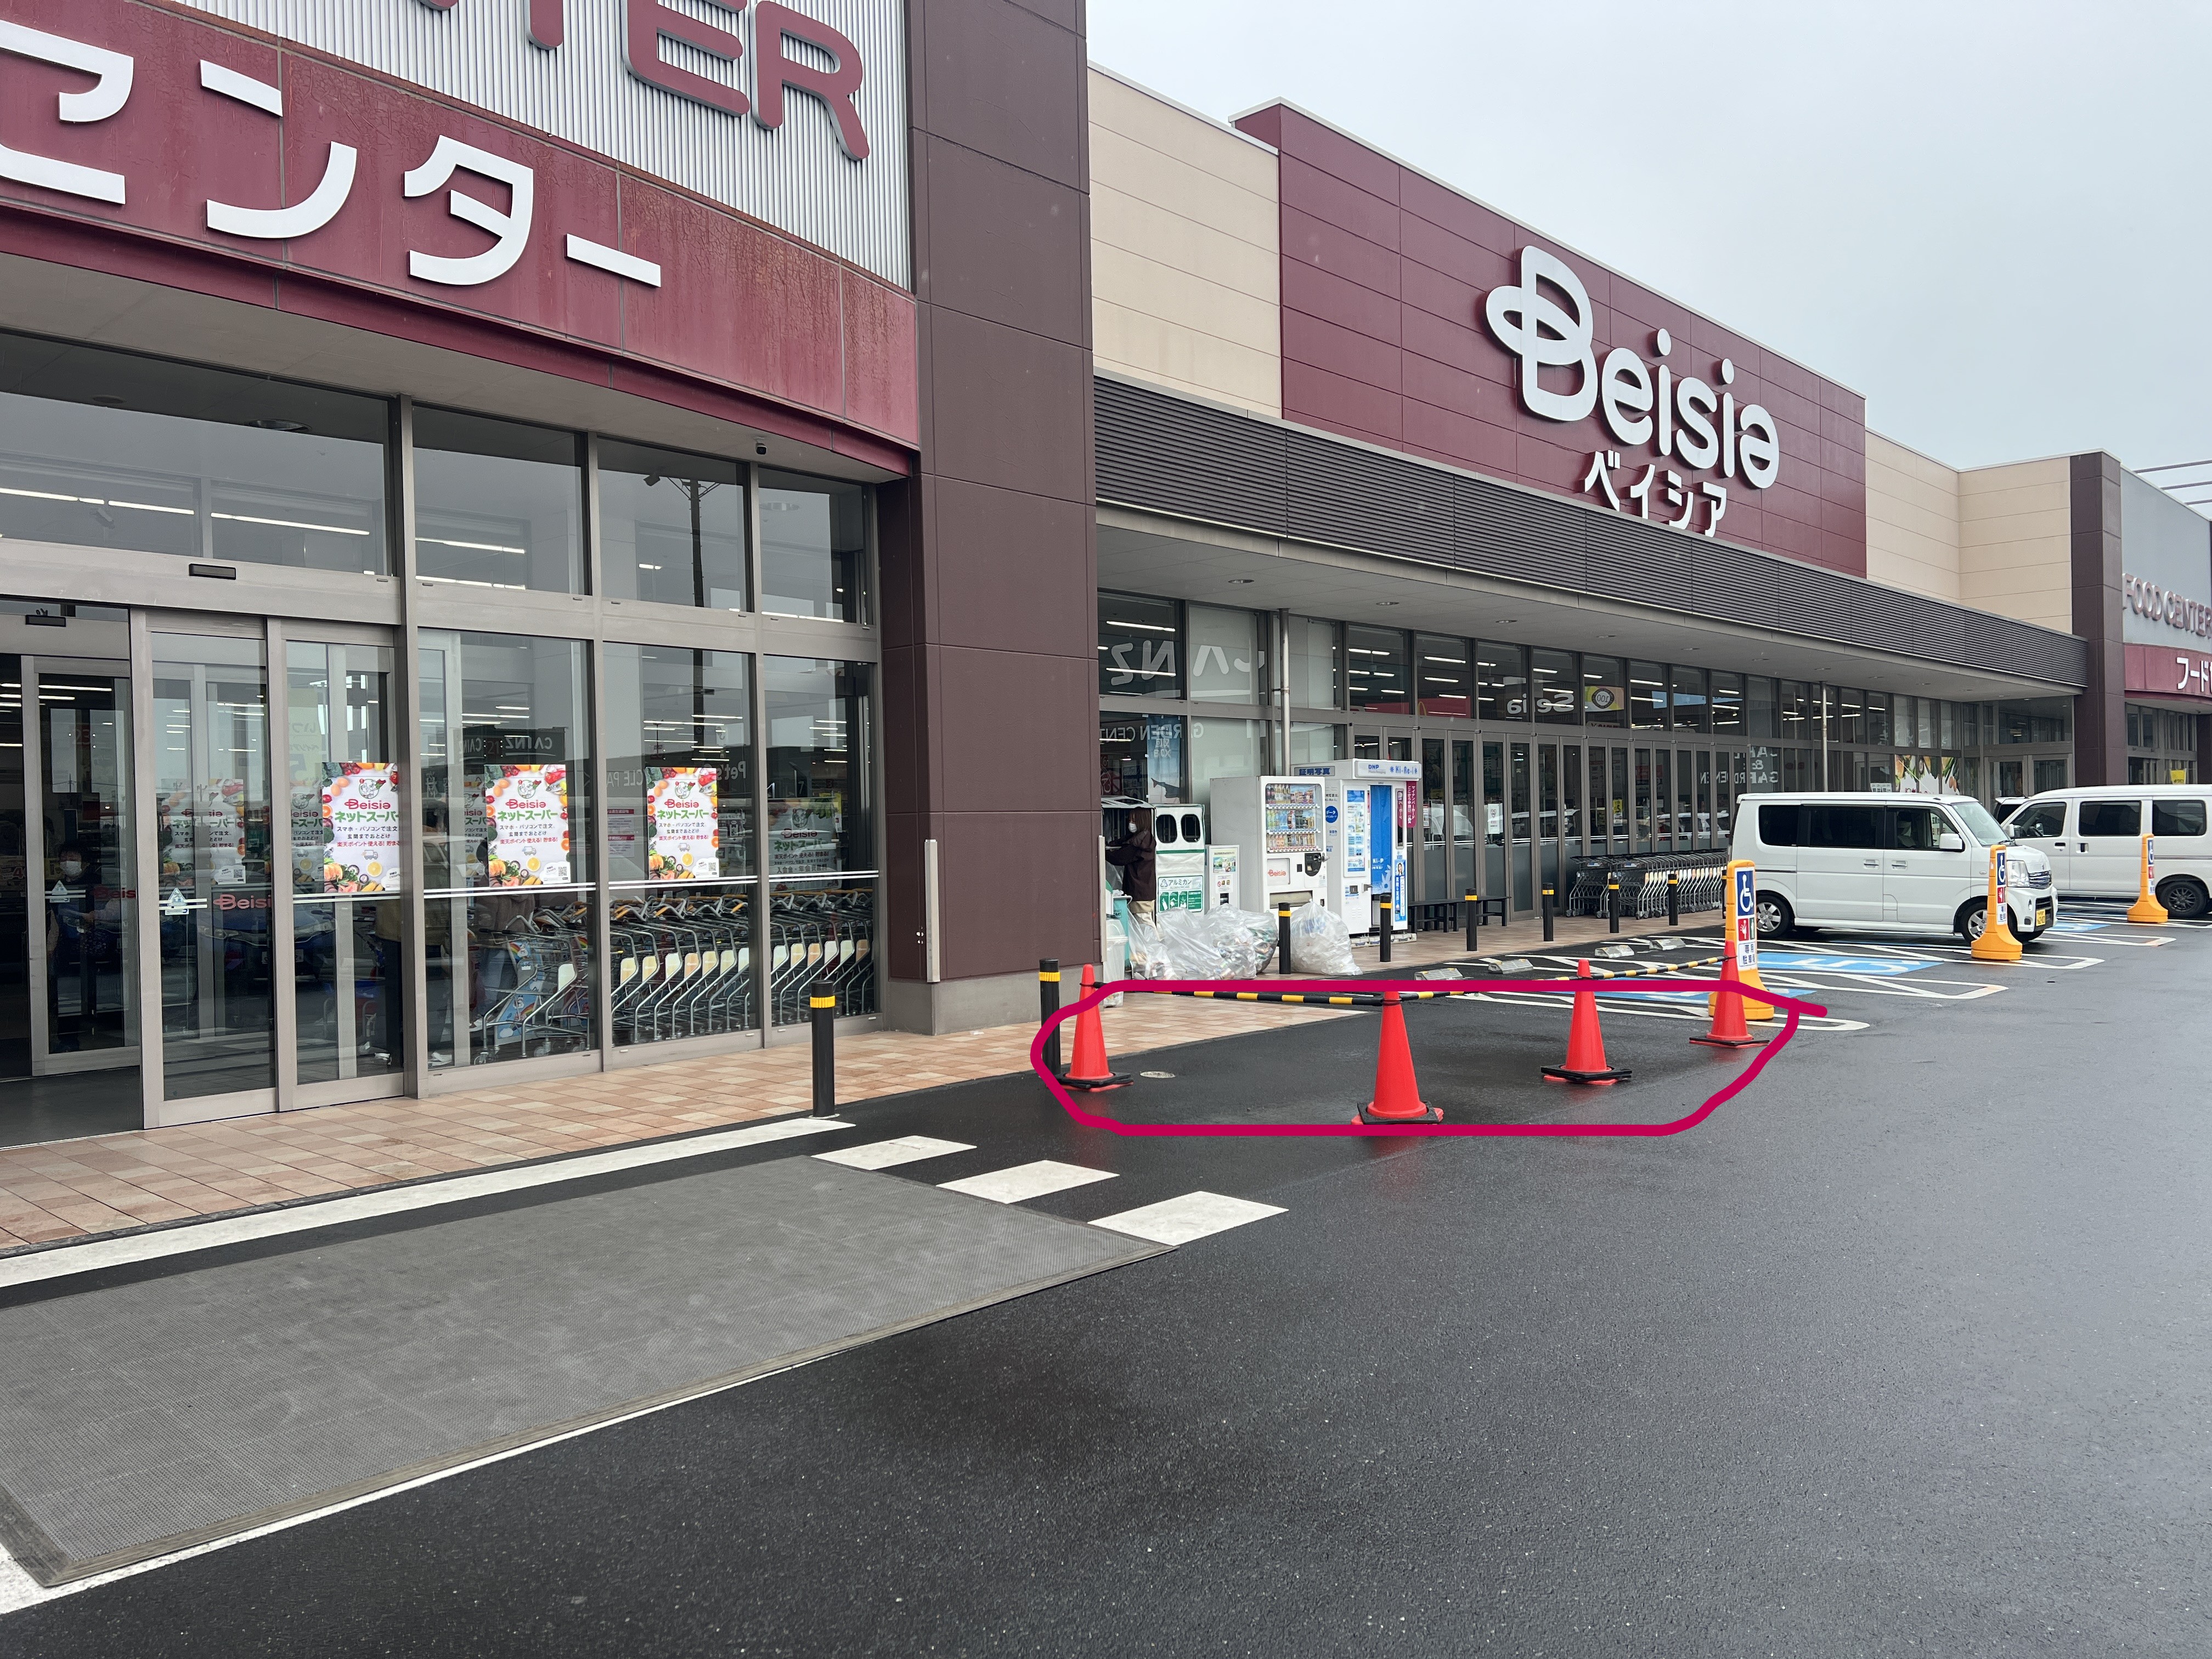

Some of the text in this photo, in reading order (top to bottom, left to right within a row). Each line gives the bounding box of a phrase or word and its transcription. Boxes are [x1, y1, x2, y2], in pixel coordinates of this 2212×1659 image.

[420, 0, 870, 161] ER
[1486, 245, 1780, 489] Beisia
[1583, 450, 1727, 537] ベイシア
[2122, 573, 2162, 621] FOOD
[2176, 657, 2212, 692] フード
[344, 799, 391, 810] Beisia
[505, 799, 546, 809] Beisia
[657, 810, 709, 820] ネットスーパー
[664, 799, 699, 808] Beisia
[498, 810, 558, 822] ネットスーパー
